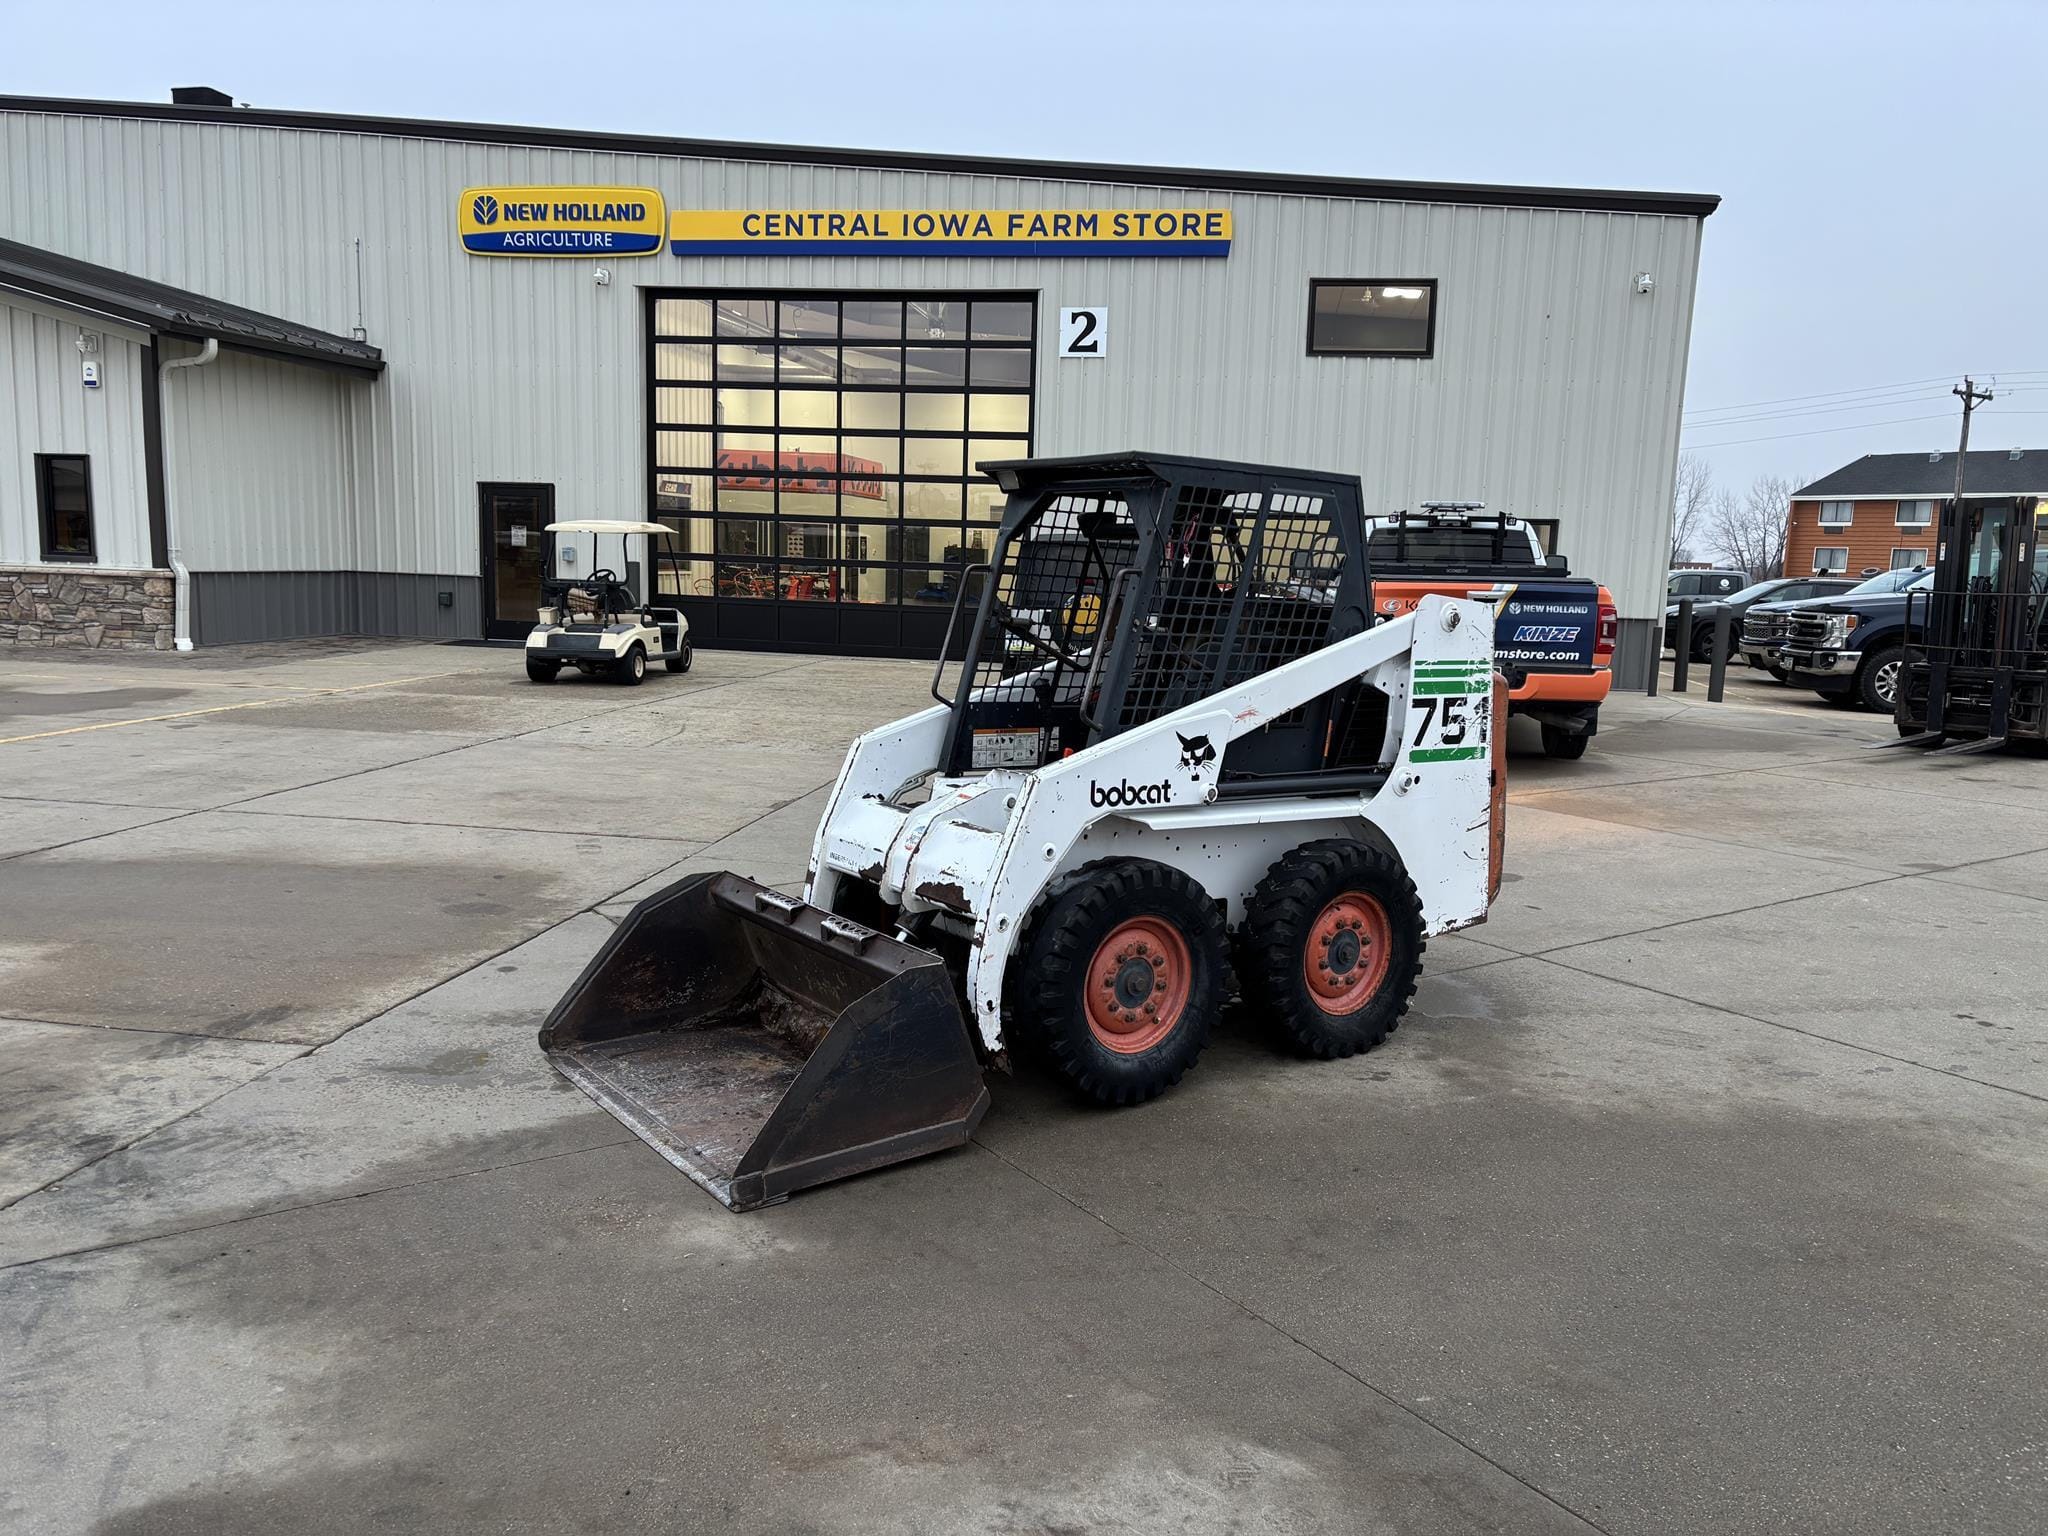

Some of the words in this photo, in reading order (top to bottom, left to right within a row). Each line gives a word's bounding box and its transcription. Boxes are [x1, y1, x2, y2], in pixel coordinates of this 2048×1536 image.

[503, 203, 546, 221] NEW
[553, 203, 645, 222] HOLLAND
[742, 213, 889, 237] CENTRAL
[902, 213, 994, 237] IOWA
[1007, 213, 1098, 237] FARM
[1112, 213, 1223, 237] STORE
[503, 232, 612, 247] AGRICULTURE
[1068, 311, 1098, 353] 2
[1523, 604, 1545, 613] NEW
[1546, 605, 1588, 614] HOLLAND
[1512, 625, 1581, 643] KINZE
[1493, 648, 1580, 661] mstore.com
[1090, 778, 1172, 808] bobcat
